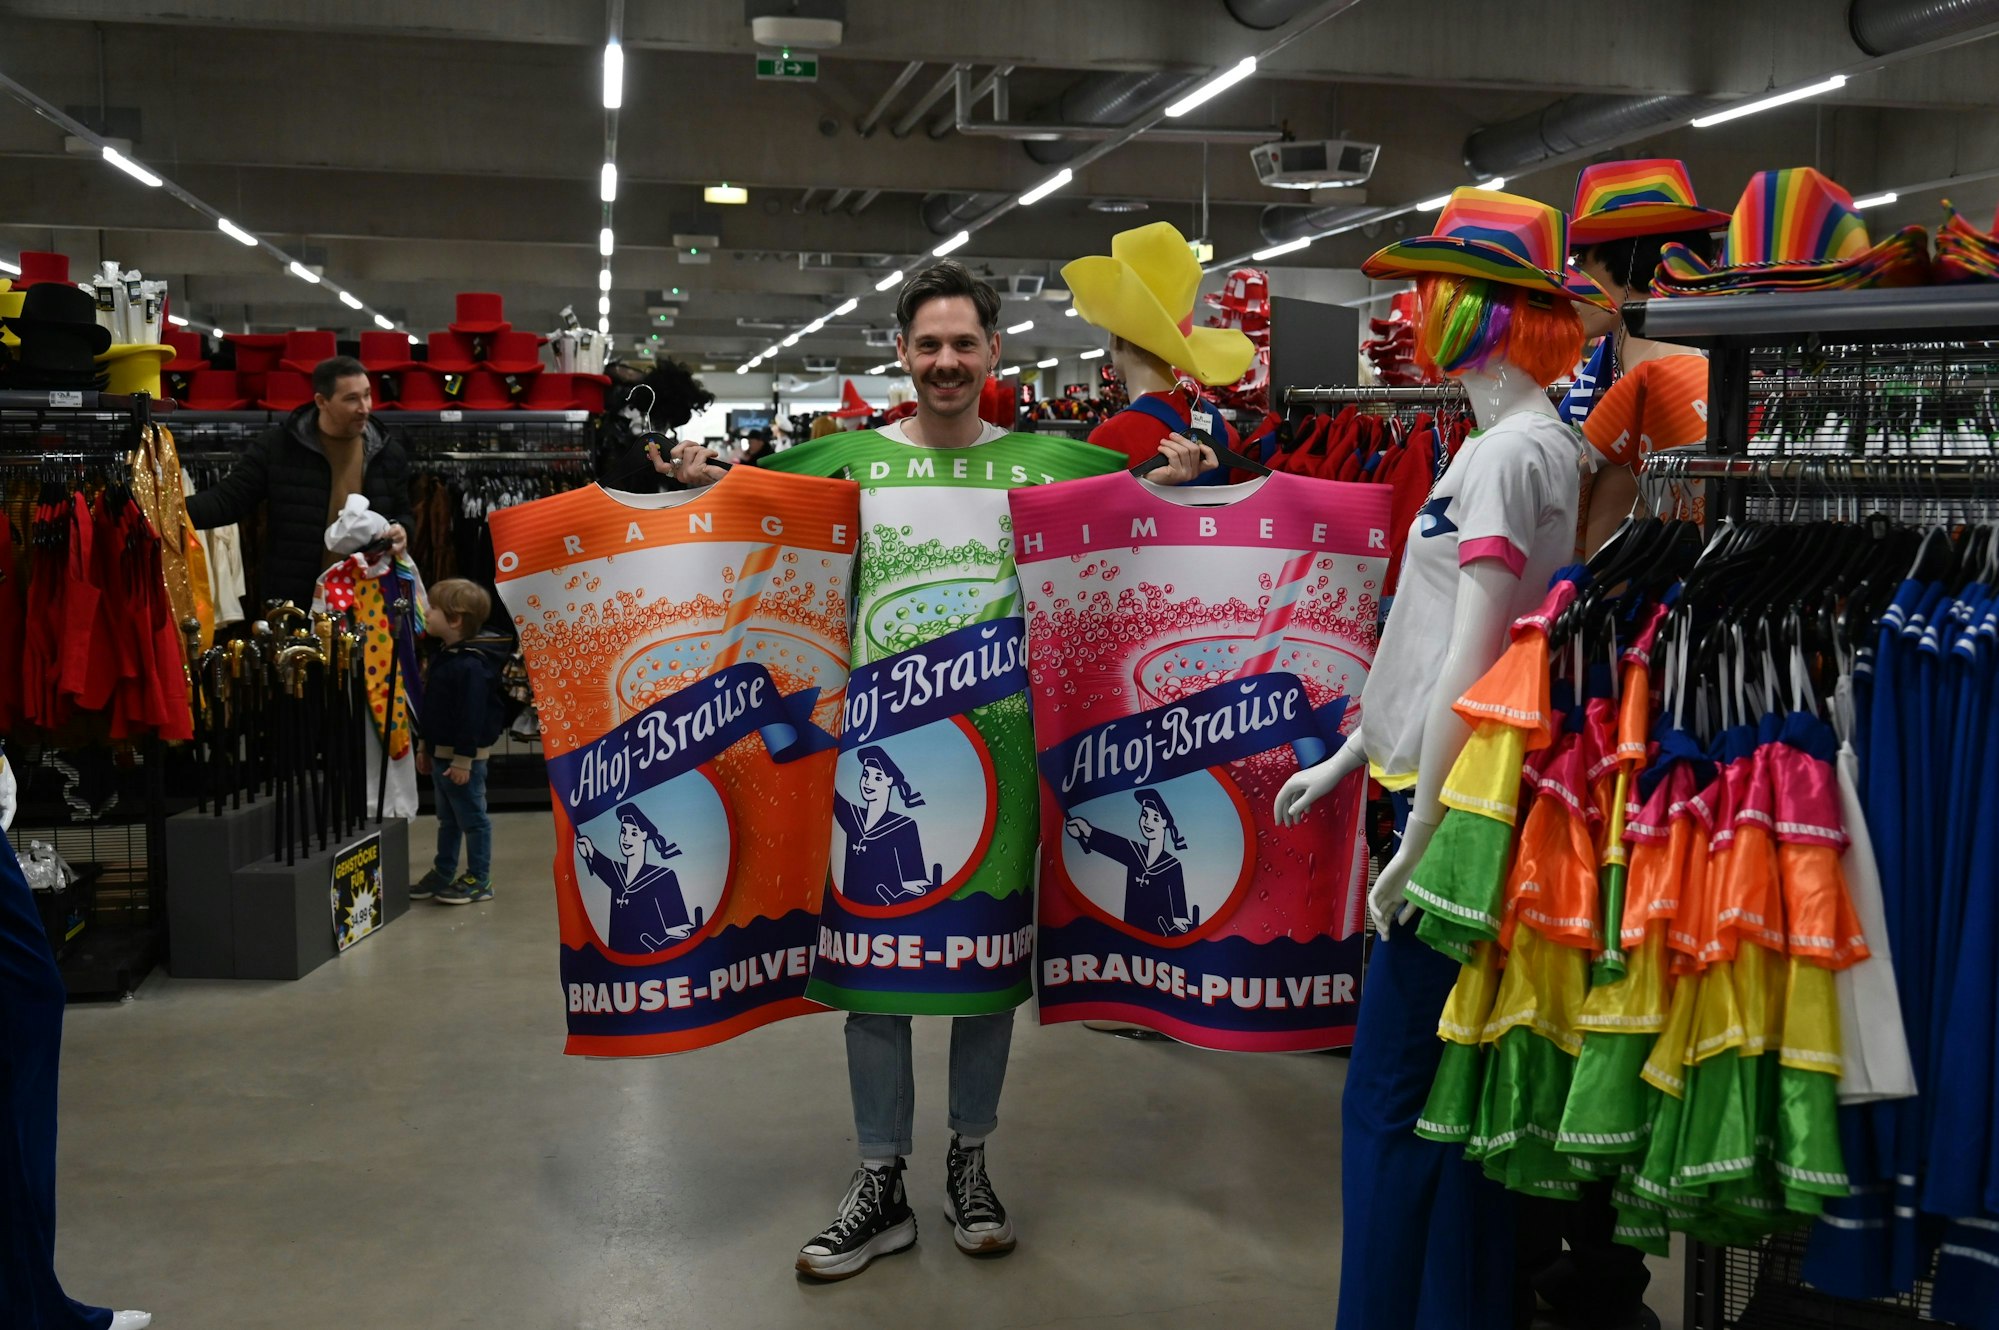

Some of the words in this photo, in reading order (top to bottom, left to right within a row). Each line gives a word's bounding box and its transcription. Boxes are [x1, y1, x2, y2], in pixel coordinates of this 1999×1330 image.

[843, 458, 1054, 485] LDMEIST
[497, 512, 848, 573] ORANGE
[1023, 516, 1385, 555] HIMBEER
[335, 844, 378, 880] GEHSTÖCKE
[350, 868, 366, 890] FÜR
[1043, 952, 1357, 1011] BRAUSE-PULVER
